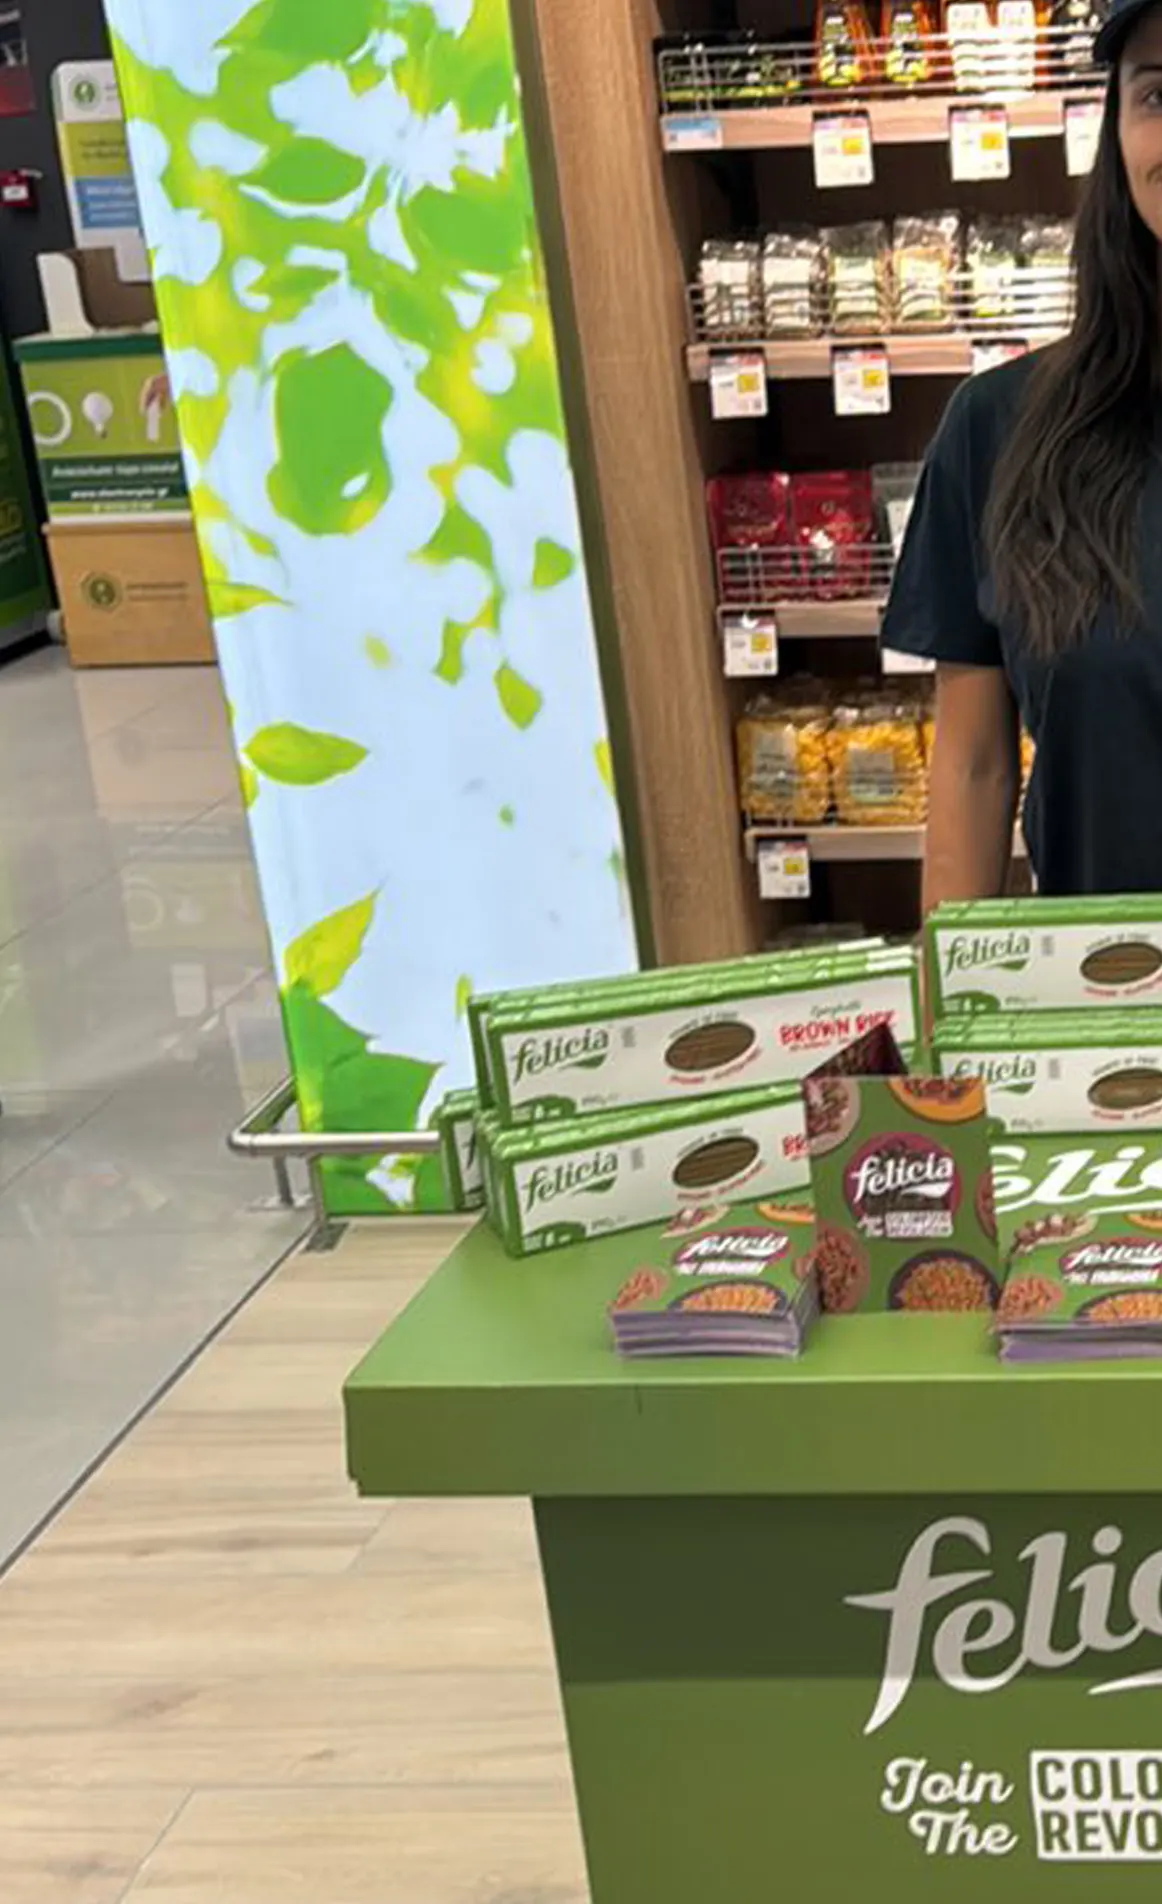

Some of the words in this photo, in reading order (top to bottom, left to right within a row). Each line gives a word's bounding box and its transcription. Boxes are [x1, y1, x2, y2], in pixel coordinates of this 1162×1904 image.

[943, 931, 1031, 976] felicia
[511, 1028, 609, 1086] felicia
[778, 1017, 852, 1046] BROWN
[521, 1151, 619, 1213] felicia
[850, 1153, 955, 1204] felicia
[881, 1756, 1014, 1811] Join
[909, 1810, 1018, 1857] The
